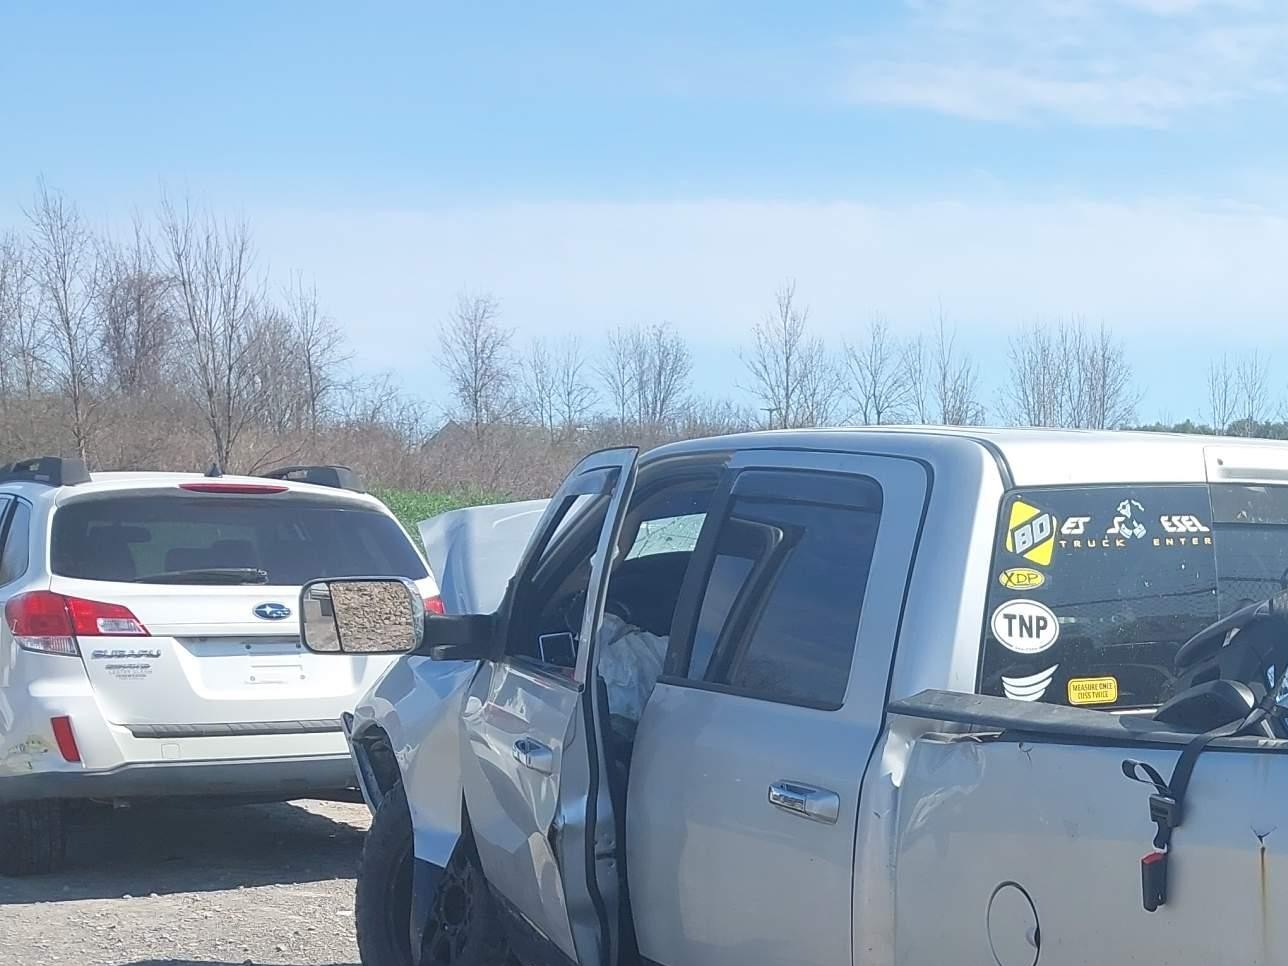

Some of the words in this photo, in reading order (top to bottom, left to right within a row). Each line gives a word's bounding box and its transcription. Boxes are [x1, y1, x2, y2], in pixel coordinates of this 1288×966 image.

[1014, 513, 1050, 554] BD
[1059, 537, 1127, 548] TRUCK
[1003, 571, 1039, 587] XDP
[1003, 613, 1048, 639] TNP
[1072, 683, 1098, 691] MEASURE
